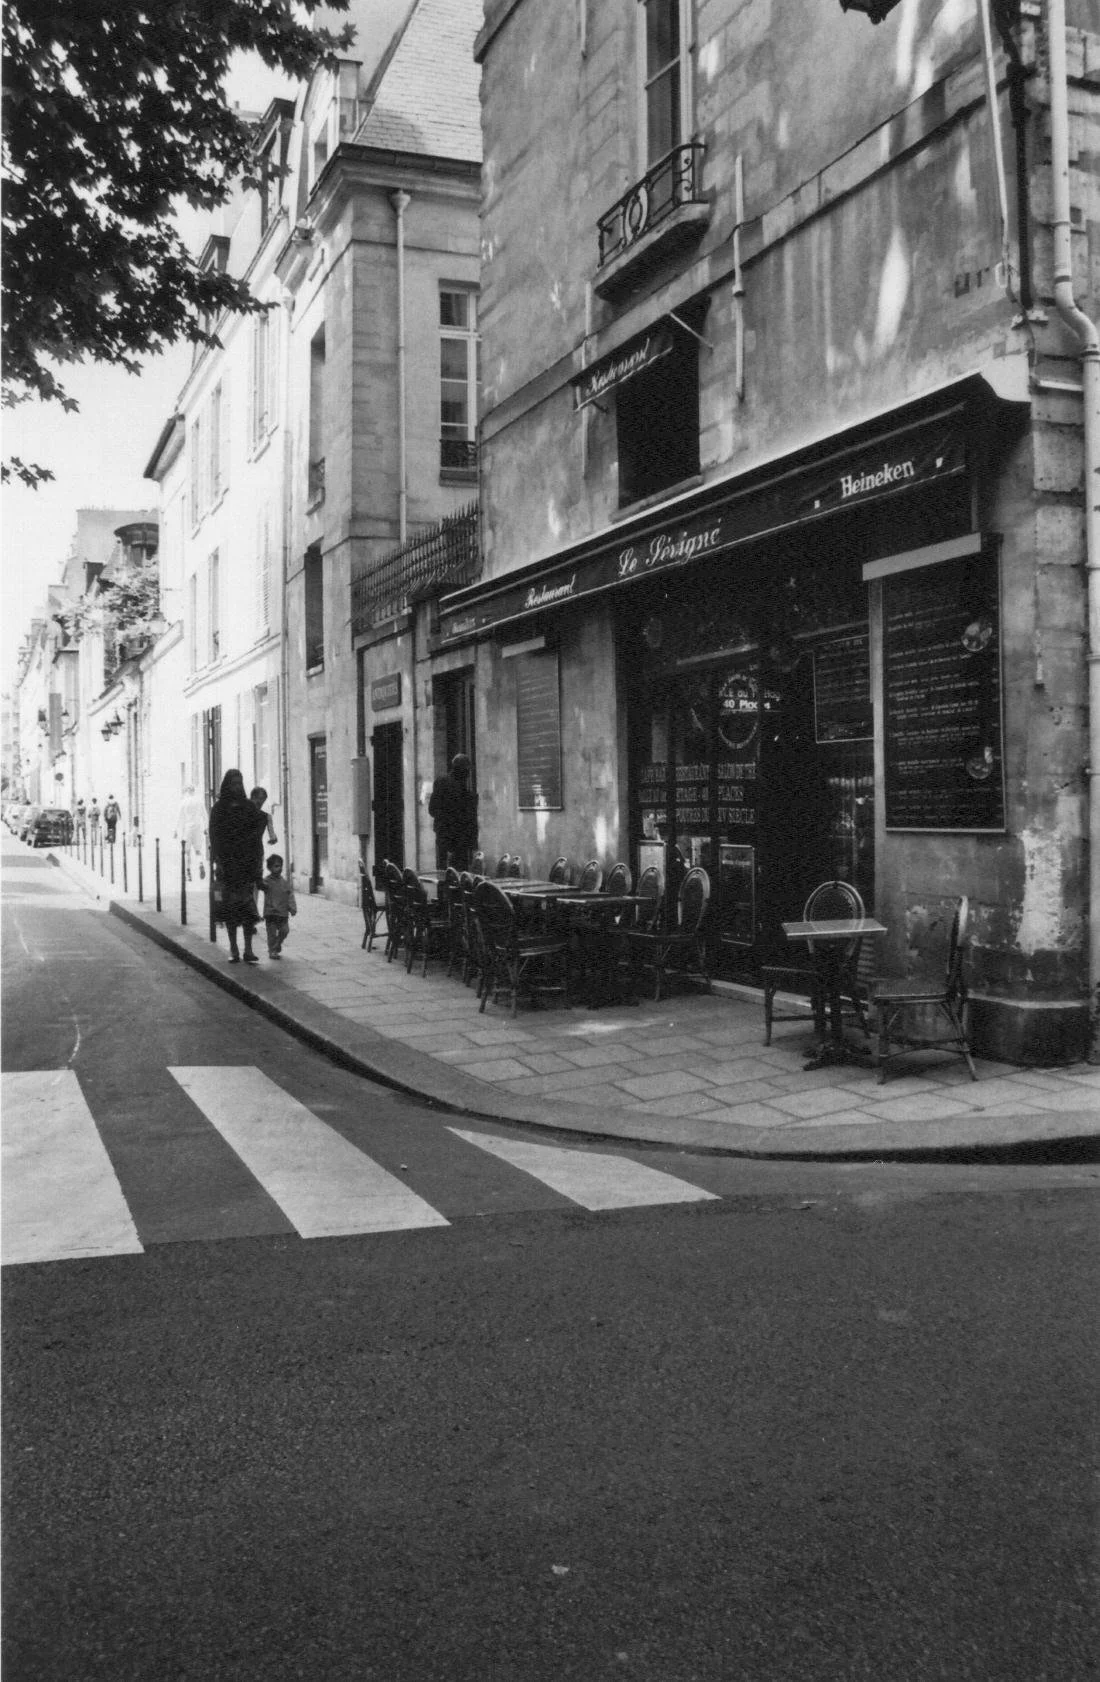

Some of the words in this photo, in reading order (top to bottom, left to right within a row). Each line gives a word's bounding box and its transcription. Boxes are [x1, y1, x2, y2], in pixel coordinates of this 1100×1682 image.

[585, 337, 650, 396] Restaurant
[840, 459, 915, 499] Heineken
[618, 547, 638, 576] Le
[645, 518, 722, 566] Sévigné
[525, 573, 577, 609] Restaurant
